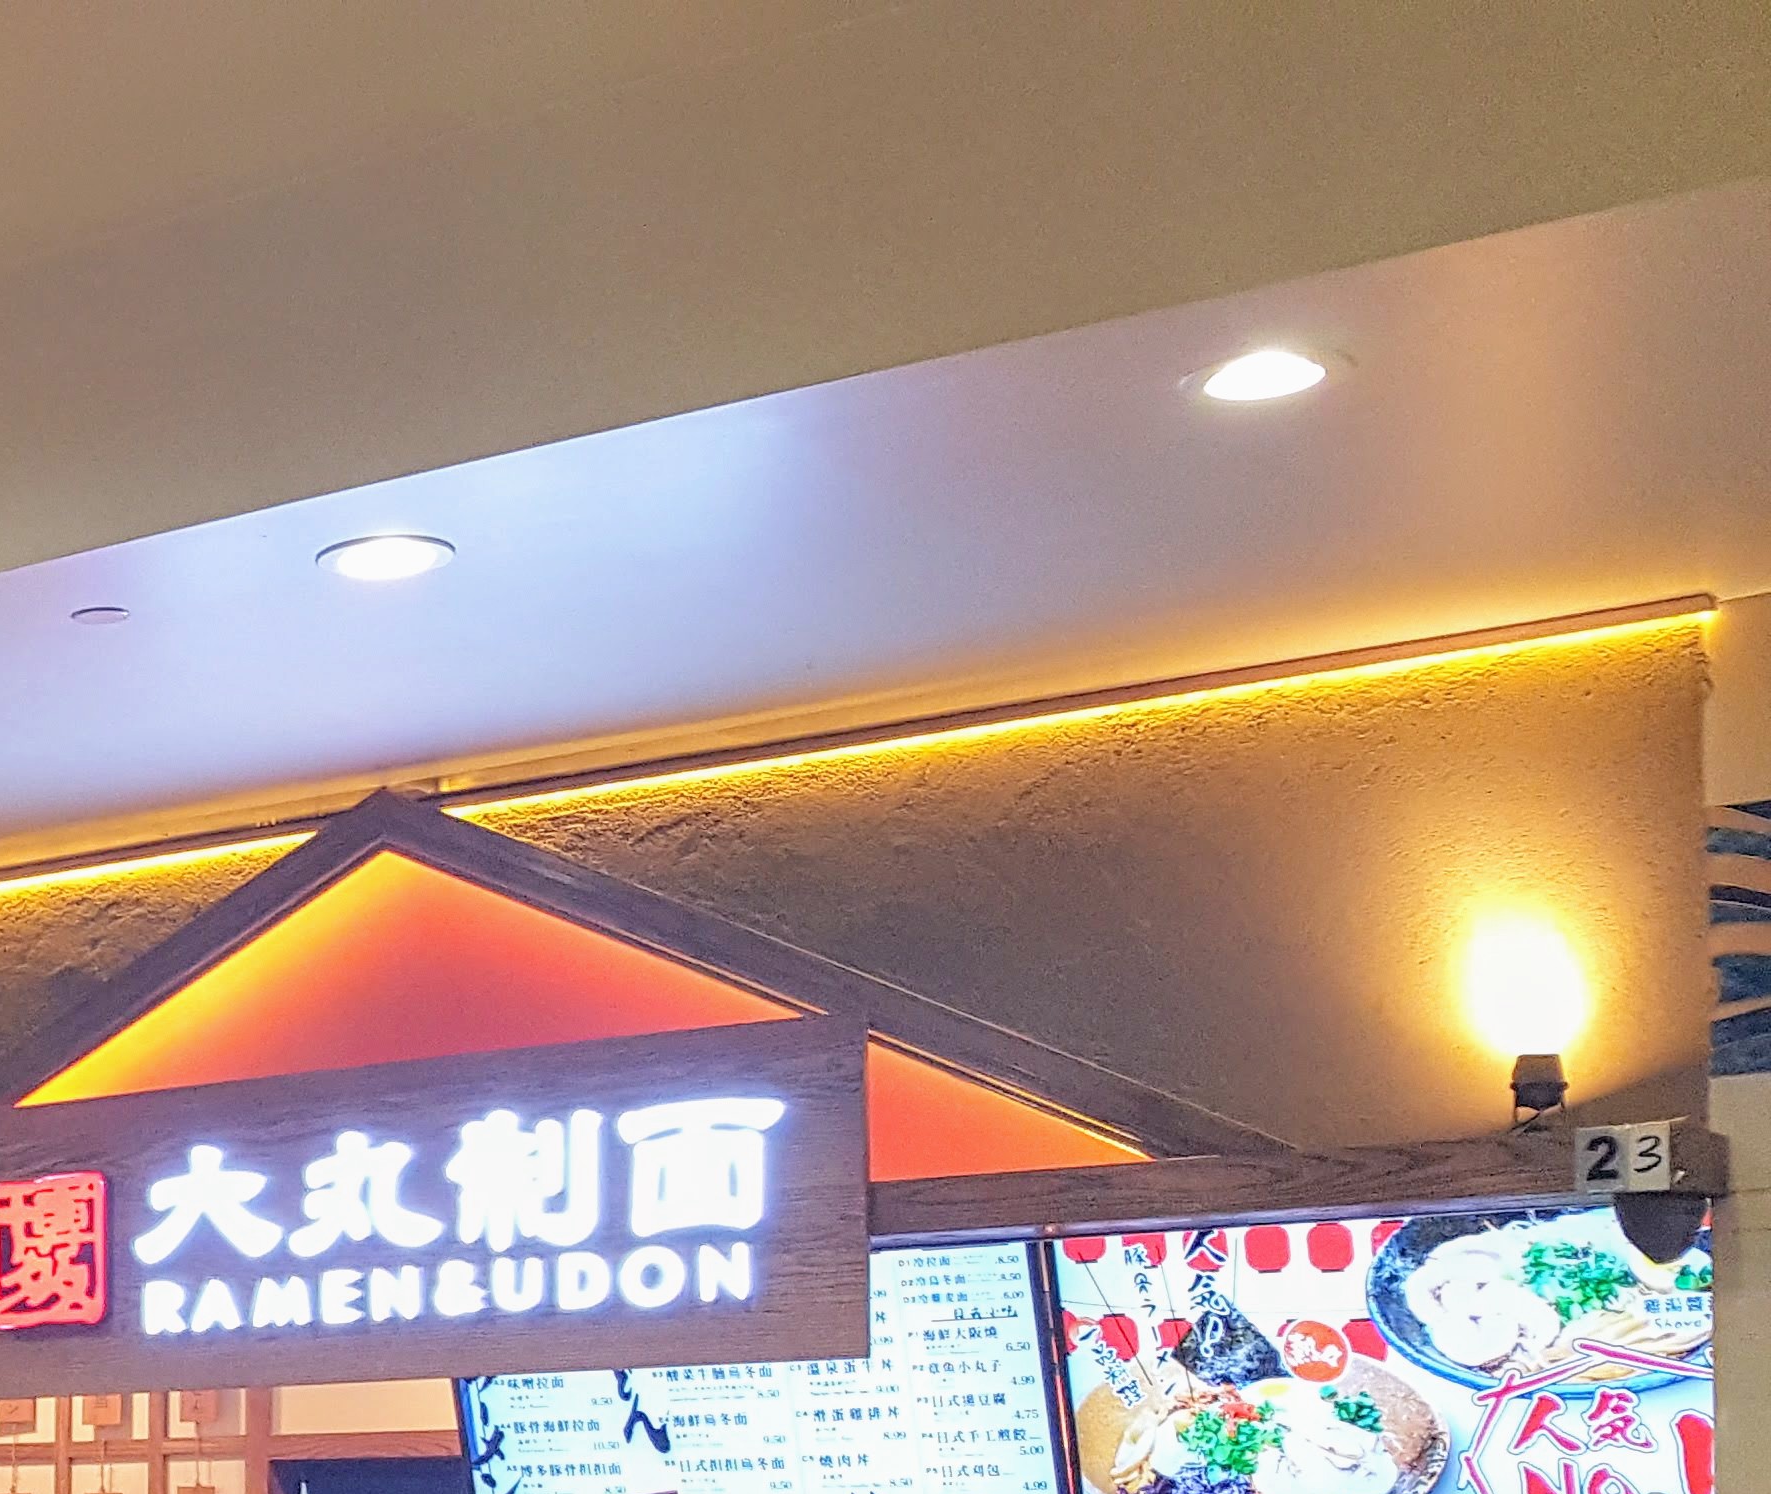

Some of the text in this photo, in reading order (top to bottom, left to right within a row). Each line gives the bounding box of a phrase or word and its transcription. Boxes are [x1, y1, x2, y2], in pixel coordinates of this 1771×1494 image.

[1585, 1136, 1667, 1183] 23
[142, 1242, 754, 1335] RAMEN&UDON
[1512, 1393, 1654, 1451] 人気
